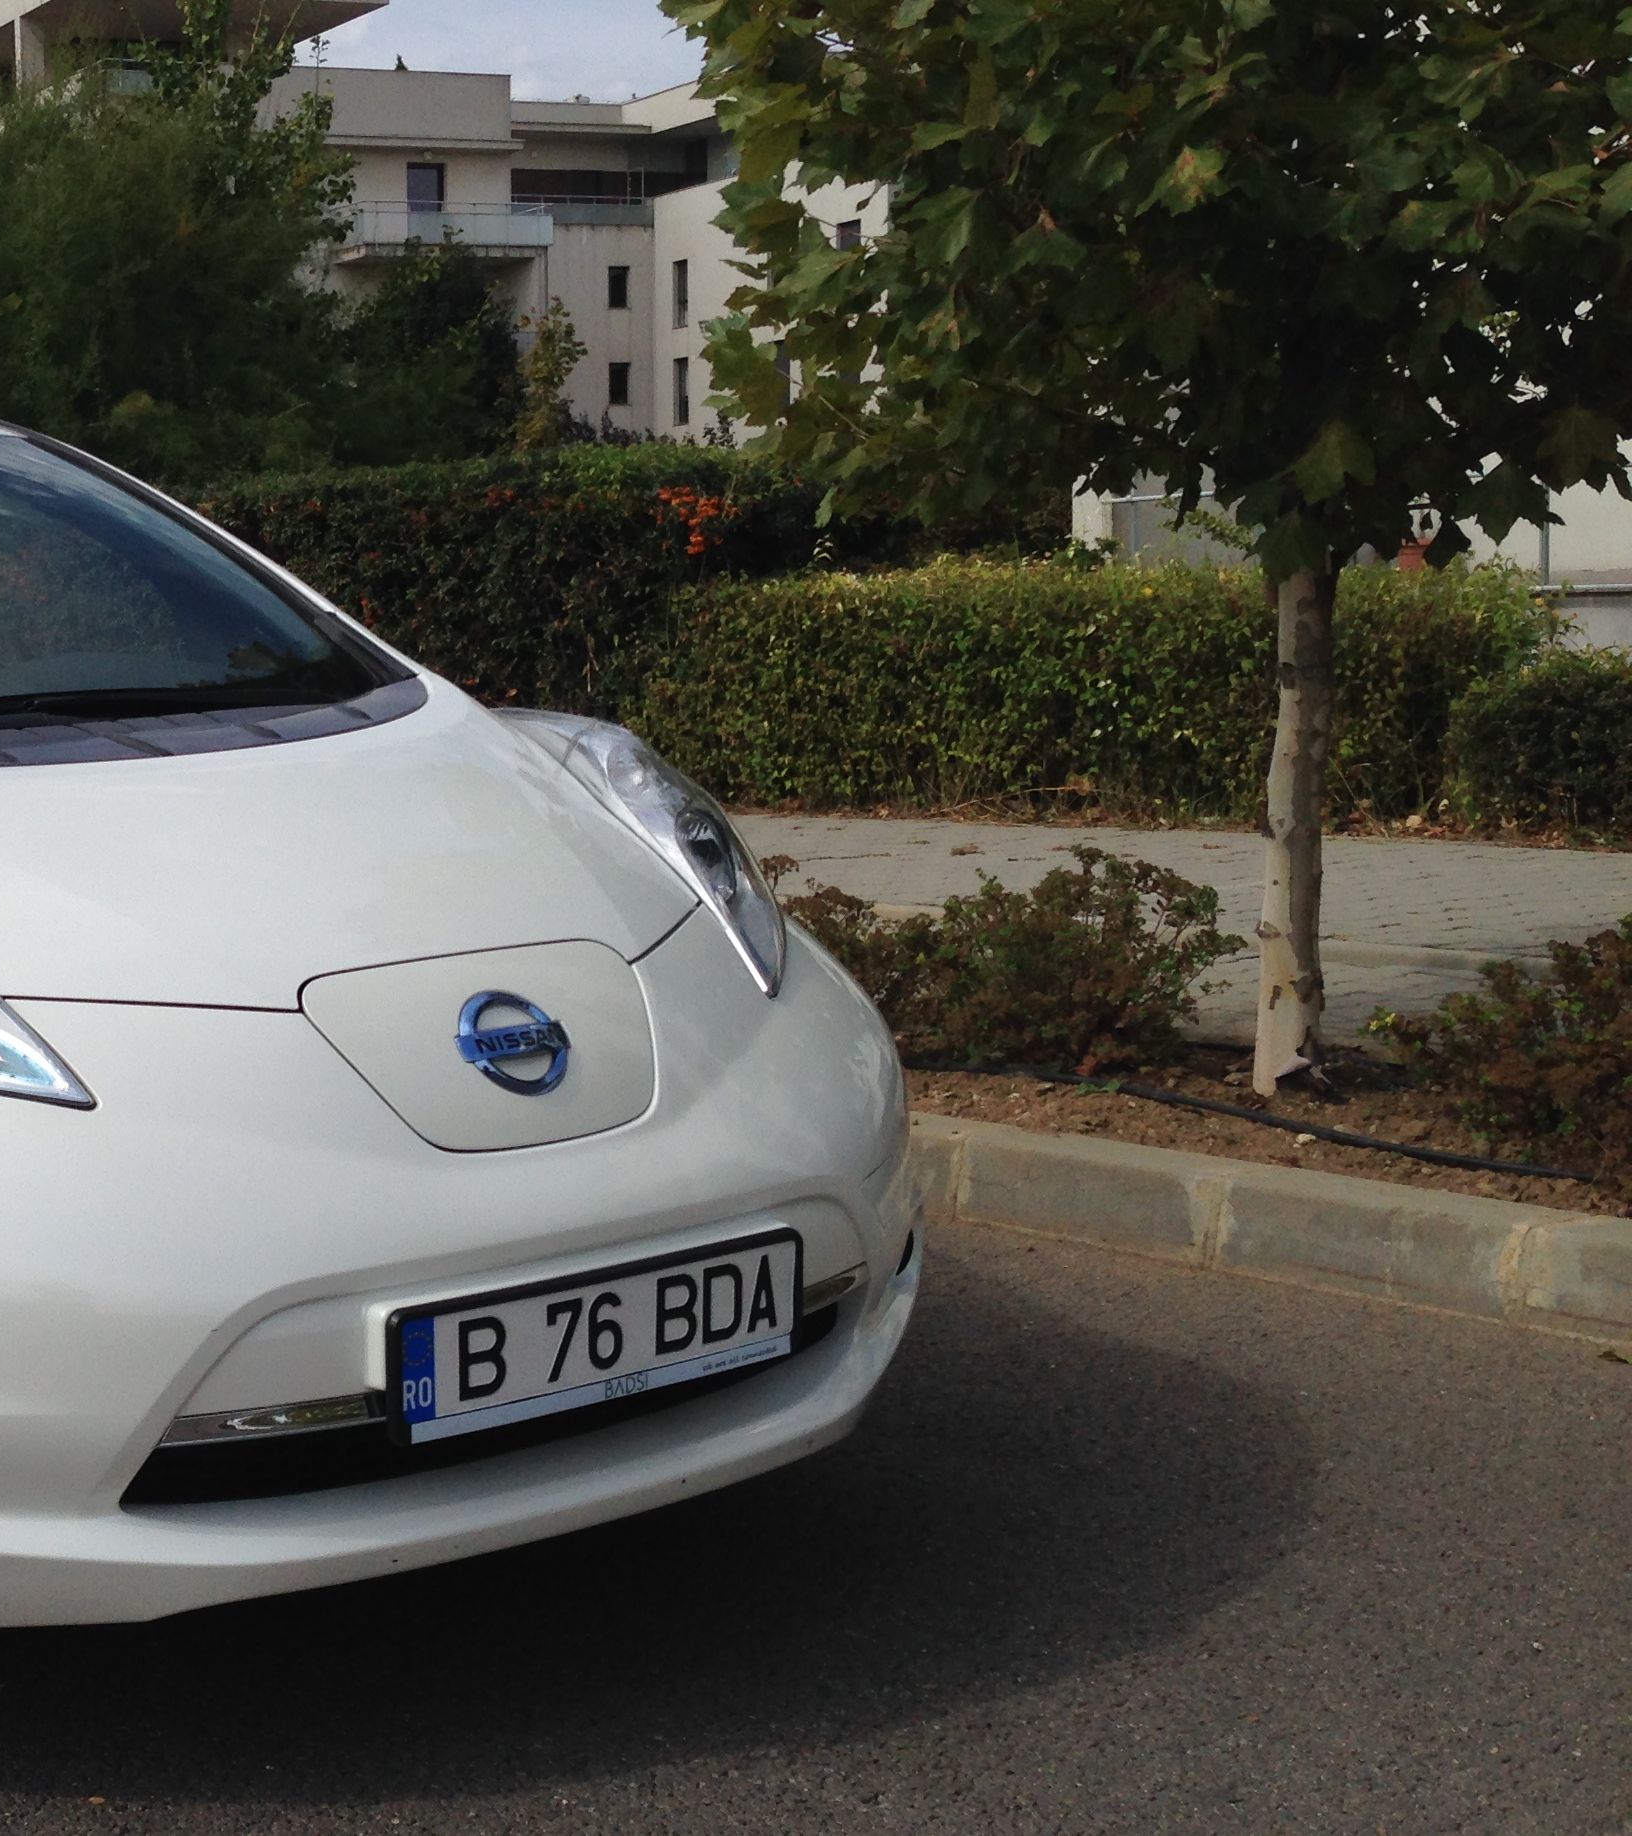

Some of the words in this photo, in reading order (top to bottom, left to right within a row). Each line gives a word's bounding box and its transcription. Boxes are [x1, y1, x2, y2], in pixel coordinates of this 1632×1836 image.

[459, 1316, 506, 1402] B
[546, 1291, 623, 1384] 76
[655, 1254, 778, 1356] BDA
[402, 1376, 432, 1411] RO
